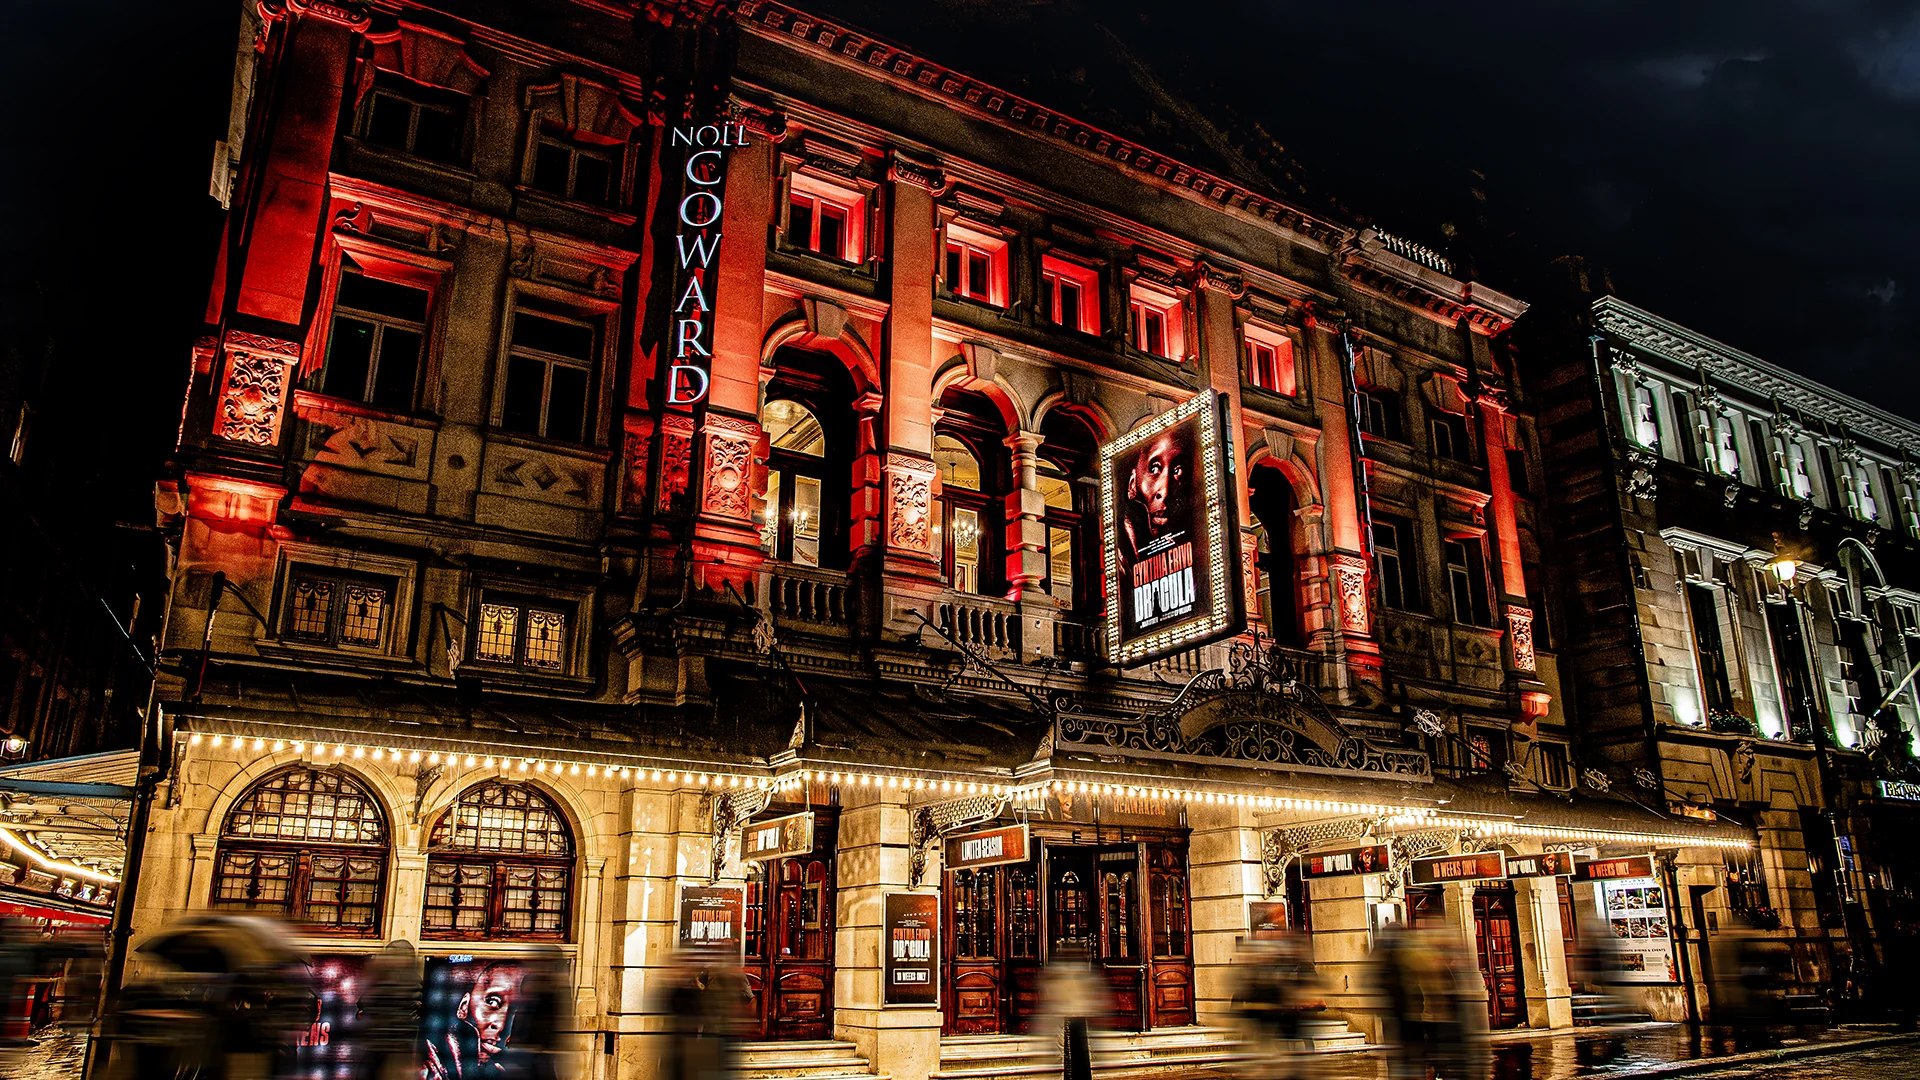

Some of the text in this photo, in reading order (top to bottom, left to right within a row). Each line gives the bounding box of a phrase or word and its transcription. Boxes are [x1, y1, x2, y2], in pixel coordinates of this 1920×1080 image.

[667, 150, 722, 404] COWARD
[1133, 553, 1168, 588] CYNTHIA
[1167, 541, 1193, 574] ERIVO
[1133, 566, 1196, 623] DRACULA
[961, 835, 1003, 861] LIMITED SEASON
[1440, 860, 1462, 878] WEEKS
[1461, 859, 1477, 876] ONLY
[1595, 862, 1616, 878] WEEKS
[1615, 861, 1630, 876] ONLY
[690, 921, 731, 939] DRACULA
[892, 939, 931, 958] DRACULA
